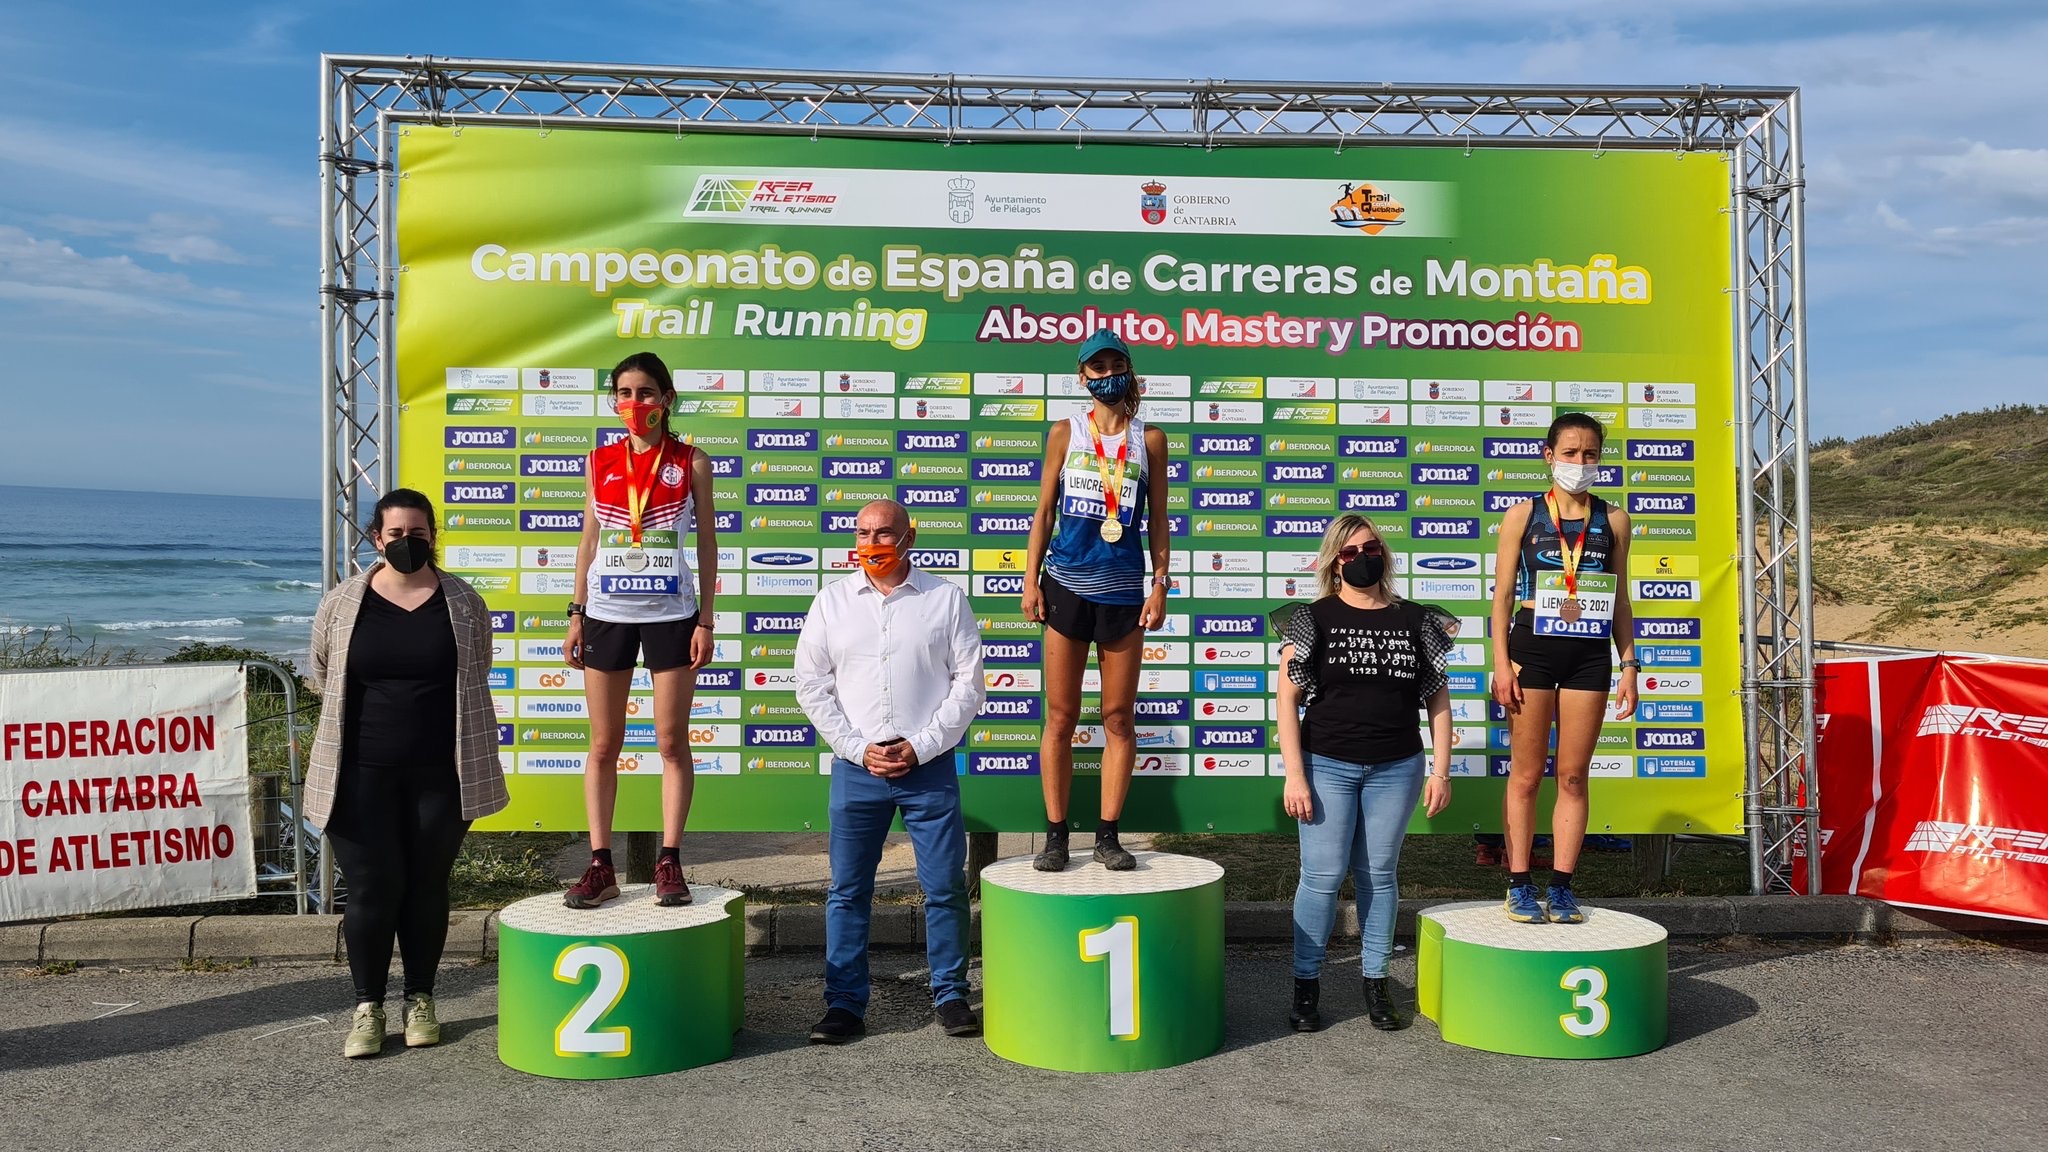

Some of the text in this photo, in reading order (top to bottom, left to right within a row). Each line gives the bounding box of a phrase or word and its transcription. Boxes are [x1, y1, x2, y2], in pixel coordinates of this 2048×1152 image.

[758, 182, 813, 191] RFEA
[753, 195, 837, 203] ATLETISMO
[984, 195, 1047, 207] Ayuntamiento
[1174, 196, 1230, 204] GOBIERNO
[1362, 189, 1390, 202] Trail
[990, 203, 1040, 215] de Piélagos
[1174, 216, 1236, 226] CANTABRIA
[471, 245, 1648, 301] Campeonato de España de Carreras de Montaña
[616, 302, 924, 344] Trail Running
[980, 303, 1579, 353] Absoluto, Master y Promoción
[844, 438, 889, 446] IBERDROLA
[466, 462, 512, 470] IBERDROLA
[919, 466, 963, 474] IBERDROLA
[1070, 476, 1103, 492] LIENCRE
[542, 490, 586, 498] IBERDROLA
[993, 494, 1038, 502] IBERDROLA
[653, 556, 672, 567] 2021
[910, 552, 956, 566] GOYA
[760, 576, 812, 588] Hipremon
[1424, 581, 1474, 592] Hipremon
[1642, 584, 1690, 597] GOYA
[1590, 600, 1608, 612] 2021
[1331, 628, 1410, 637] UNDERVOICE
[540, 674, 565, 688] GO
[536, 703, 581, 712] MONDO
[1968, 708, 2048, 735] RFE
[4, 715, 215, 761] FEDERACION
[540, 732, 586, 740] IBERDROLA
[1961, 727, 2048, 748] ATLETISM
[536, 760, 581, 768] MONDO
[22, 773, 202, 818] CANTABRA
[1961, 825, 2048, 849] RFE
[0, 824, 234, 876] DE ATLETISMO
[1953, 845, 2048, 864] ATLETISM
[1084, 921, 1134, 1037] 1
[557, 945, 626, 1053] 2
[1563, 967, 1608, 1038] 3
